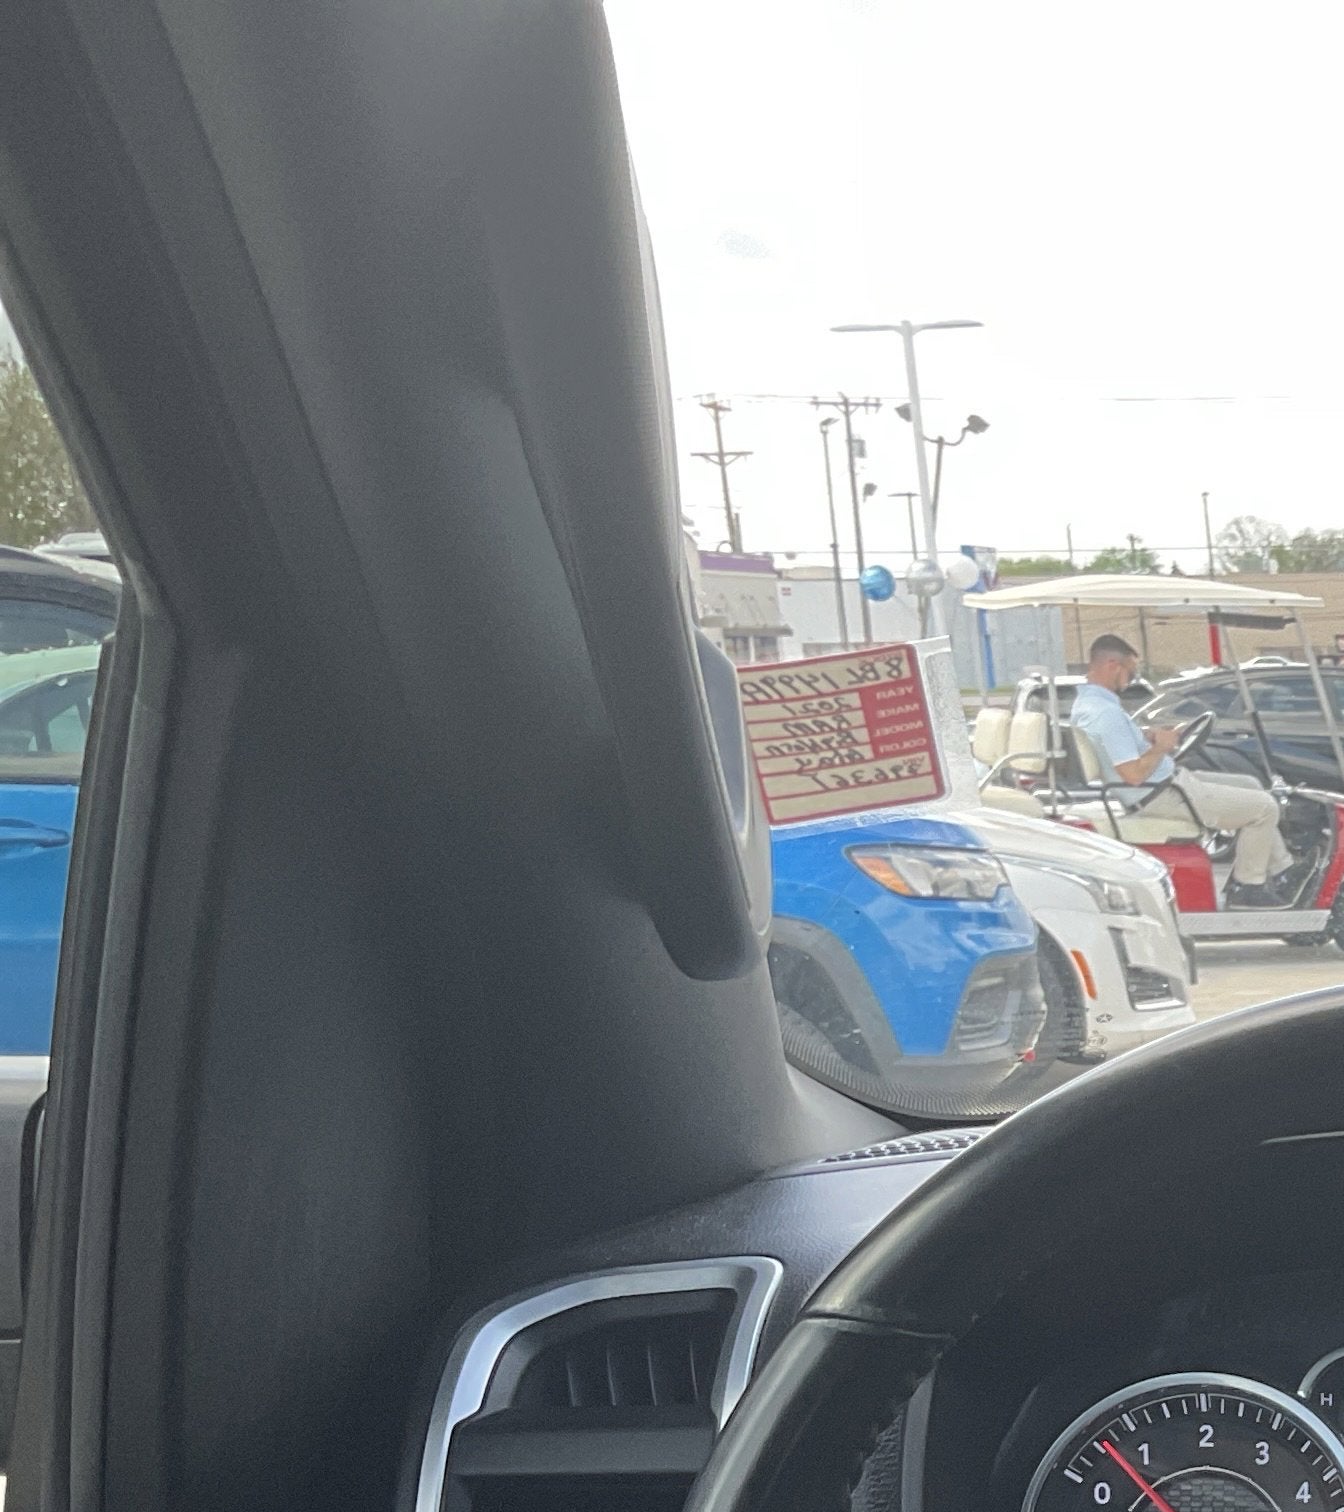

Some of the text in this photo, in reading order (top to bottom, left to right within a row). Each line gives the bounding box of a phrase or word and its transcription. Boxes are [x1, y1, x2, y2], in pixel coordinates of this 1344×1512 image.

[1320, 1392, 1334, 1407] H
[1199, 1424, 1215, 1448] 2
[1138, 1443, 1151, 1466] 1
[1255, 1441, 1271, 1465] 3
[1093, 1482, 1111, 1505] 0
[1295, 1481, 1312, 1504] 4
